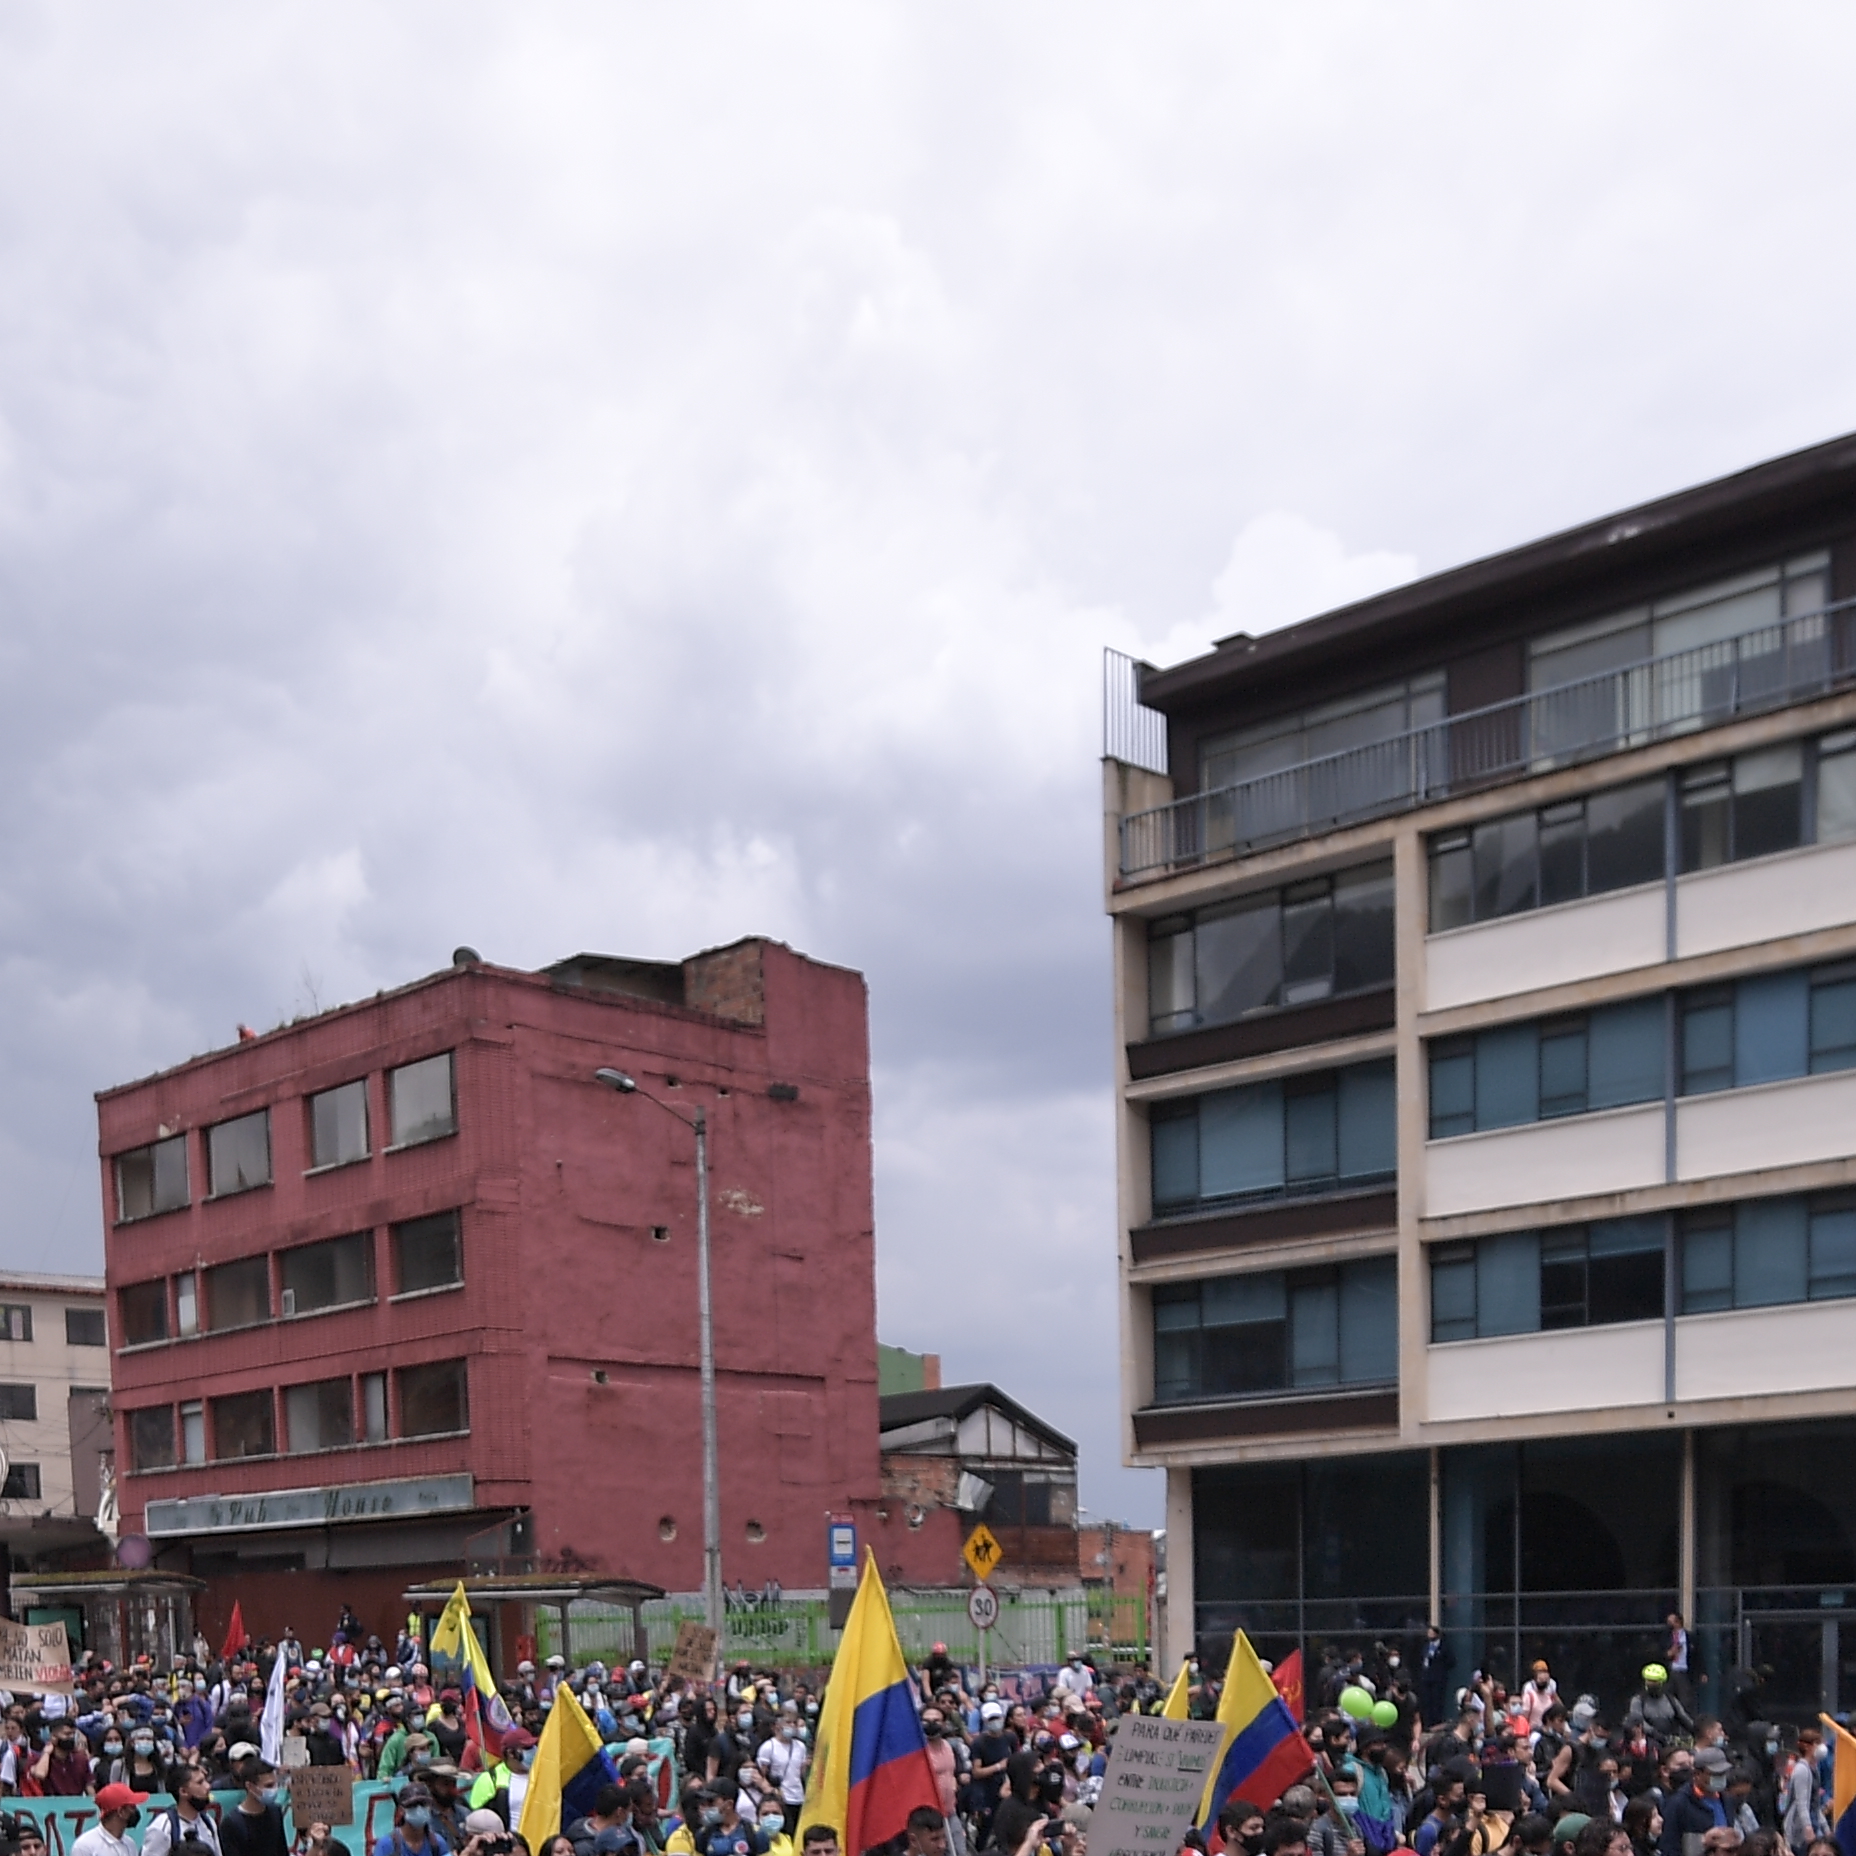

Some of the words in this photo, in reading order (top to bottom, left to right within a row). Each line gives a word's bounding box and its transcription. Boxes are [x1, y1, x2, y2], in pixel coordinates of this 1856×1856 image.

[975, 1598, 992, 1616] 30
[38, 1628, 63, 1648] SOLO
[1132, 1722, 1159, 1740] PARA
